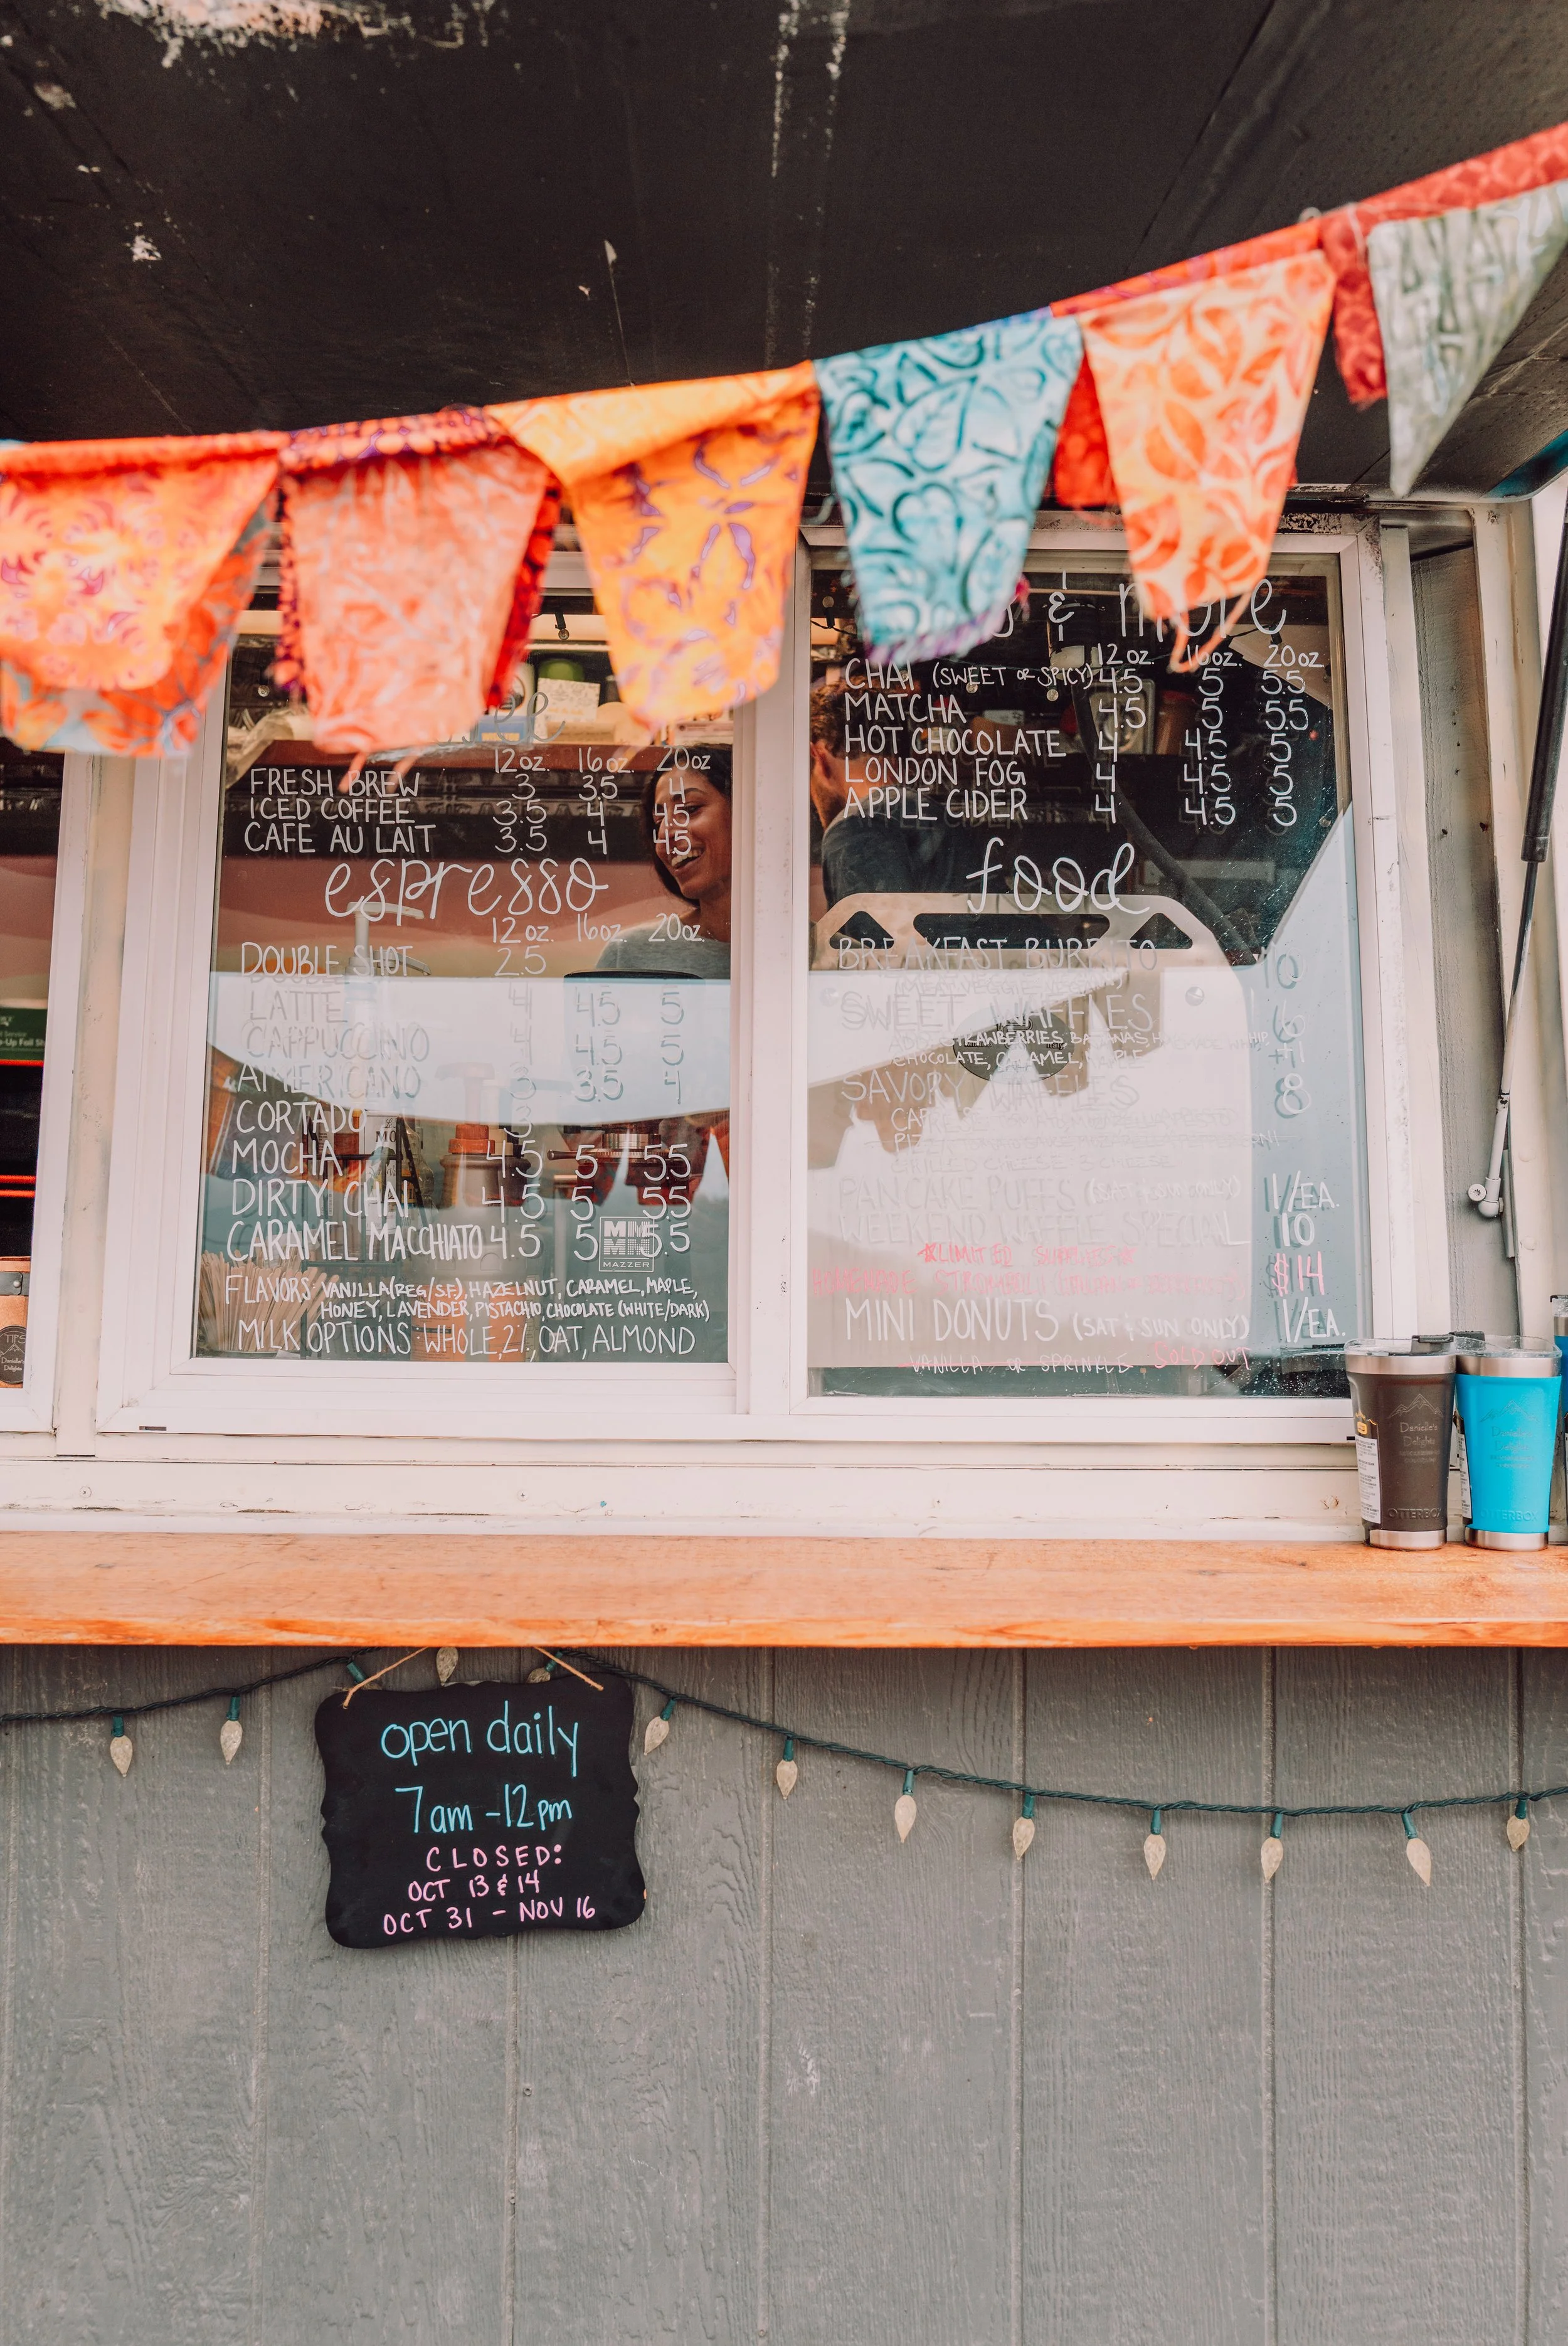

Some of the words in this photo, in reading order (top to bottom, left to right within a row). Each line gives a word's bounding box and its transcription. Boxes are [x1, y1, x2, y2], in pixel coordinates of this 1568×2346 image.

[845, 659, 914, 691] CHAI
[933, 662, 1005, 689] (SWEET
[1037, 662, 1094, 688] SPICY)
[1099, 668, 1143, 696] 4.5
[1198, 669, 1224, 698] 5
[1261, 669, 1306, 696] 5.5
[845, 694, 967, 724] MATCHA
[1099, 699, 1147, 730] 4.5
[1201, 698, 1224, 730] 5
[1265, 699, 1309, 731] 5.5
[845, 725, 903, 755] HOT
[913, 728, 1067, 758] CHOCOLATE
[1099, 732, 1117, 762] 4
[1185, 729, 1227, 760] 4.5
[1270, 733, 1292, 763] 5
[250, 768, 334, 797] FRESH
[348, 771, 420, 799] BREW
[512, 774, 536, 800] 3
[579, 775, 618, 805] 3.5
[669, 778, 686, 804] 4
[844, 757, 958, 785] LONDON
[975, 761, 1026, 786] FOG
[1096, 765, 1116, 792] 4
[1184, 763, 1231, 795] 4.5
[1271, 765, 1294, 796] 5
[250, 797, 316, 824] ICED
[321, 798, 415, 825] COFFEE
[493, 799, 548, 826] 3.5
[587, 801, 605, 826] 4
[654, 802, 691, 828] 4.5
[843, 787, 936, 820] APPLE
[946, 788, 1028, 821] CIDER
[1095, 795, 1116, 824] 4
[1185, 794, 1236, 826] 4.5
[1273, 795, 1297, 827] 5
[245, 824, 315, 853] CAFE
[330, 825, 363, 853] AU
[376, 824, 436, 853] LAIT
[494, 825, 548, 853] 3.5
[587, 829, 607, 855] 4
[652, 829, 692, 856] 4.5
[325, 858, 609, 926] espresso
[966, 837, 1152, 915] food
[241, 942, 343, 978] DOUBLE
[353, 945, 413, 978] SHOT
[494, 945, 546, 976] 2.5
[839, 937, 1007, 972] BREAKFAST
[1025, 938, 1157, 972] BURRITO
[250, 990, 347, 1024] LATTE
[660, 985, 684, 1025] 5
[840, 991, 967, 1031] SWEET
[1278, 1000, 1306, 1040] 6
[660, 1029, 684, 1066] 5
[1071, 1031, 1150, 1048] BAANAS,
[238, 1063, 421, 1099] AMERICANO
[842, 1069, 967, 1107] SAVORY
[1281, 1073, 1311, 1114] 8
[236, 1100, 367, 1135] CORTADO
[504, 1106, 532, 1137] 3
[232, 1138, 342, 1176] MOCHA
[486, 1140, 543, 1178] 4.5
[575, 1145, 598, 1179] 5
[644, 1144, 690, 1181] 5.5
[232, 1179, 328, 1216] DIRTY
[344, 1181, 408, 1216] CHAI
[482, 1184, 544, 1223] 4.5
[570, 1187, 593, 1220] 5
[643, 1186, 690, 1219] 5.5
[227, 1219, 358, 1261] CARAMEL
[369, 1222, 482, 1261] MACCHIATO
[490, 1224, 540, 1259] 4.5
[574, 1224, 598, 1261] 5
[640, 1222, 689, 1256] 5.5
[1281, 1213, 1315, 1248] 10
[469, 1278, 561, 1299] HAZELNUT,
[566, 1278, 645, 1297] CARAMEL,
[647, 1277, 698, 1298] MAPLE,
[1272, 1251, 1324, 1297] $14
[320, 1300, 382, 1322] HONEY,
[386, 1300, 472, 1320] LAVENDER,
[546, 1302, 614, 1318] CHOCOLATE
[618, 1300, 709, 1322] (WHITE/DARK)
[845, 1298, 914, 1342] MINI
[933, 1298, 1059, 1342] DONUTS
[1073, 1312, 1116, 1341] (SAT
[1142, 1317, 1179, 1337] SUN
[1191, 1314, 1249, 1340] ONLY)
[4, 1334, 26, 1344] TIPS
[238, 1320, 300, 1351] MILK
[424, 1323, 502, 1360] WHOLE,
[539, 1325, 587, 1360] OAT,
[592, 1324, 696, 1355] ALMOND
[1155, 1341, 1205, 1370] SOLD
[1211, 1347, 1251, 1370] OUT
[1388, 1507, 1441, 1520] OTTERBOX
[381, 1717, 472, 1766] open
[487, 1701, 578, 1777] daily
[426, 1844, 562, 1872] CLOSED:
[408, 1879, 450, 1902] OCT
[469, 1876, 489, 1898] 13
[497, 1874, 507, 1896] &
[517, 1870, 540, 1893] 14
[383, 1909, 432, 1935] OCT
[447, 1908, 472, 1929] 31
[520, 1897, 563, 1921] NOV
[576, 1896, 595, 1919] 16
